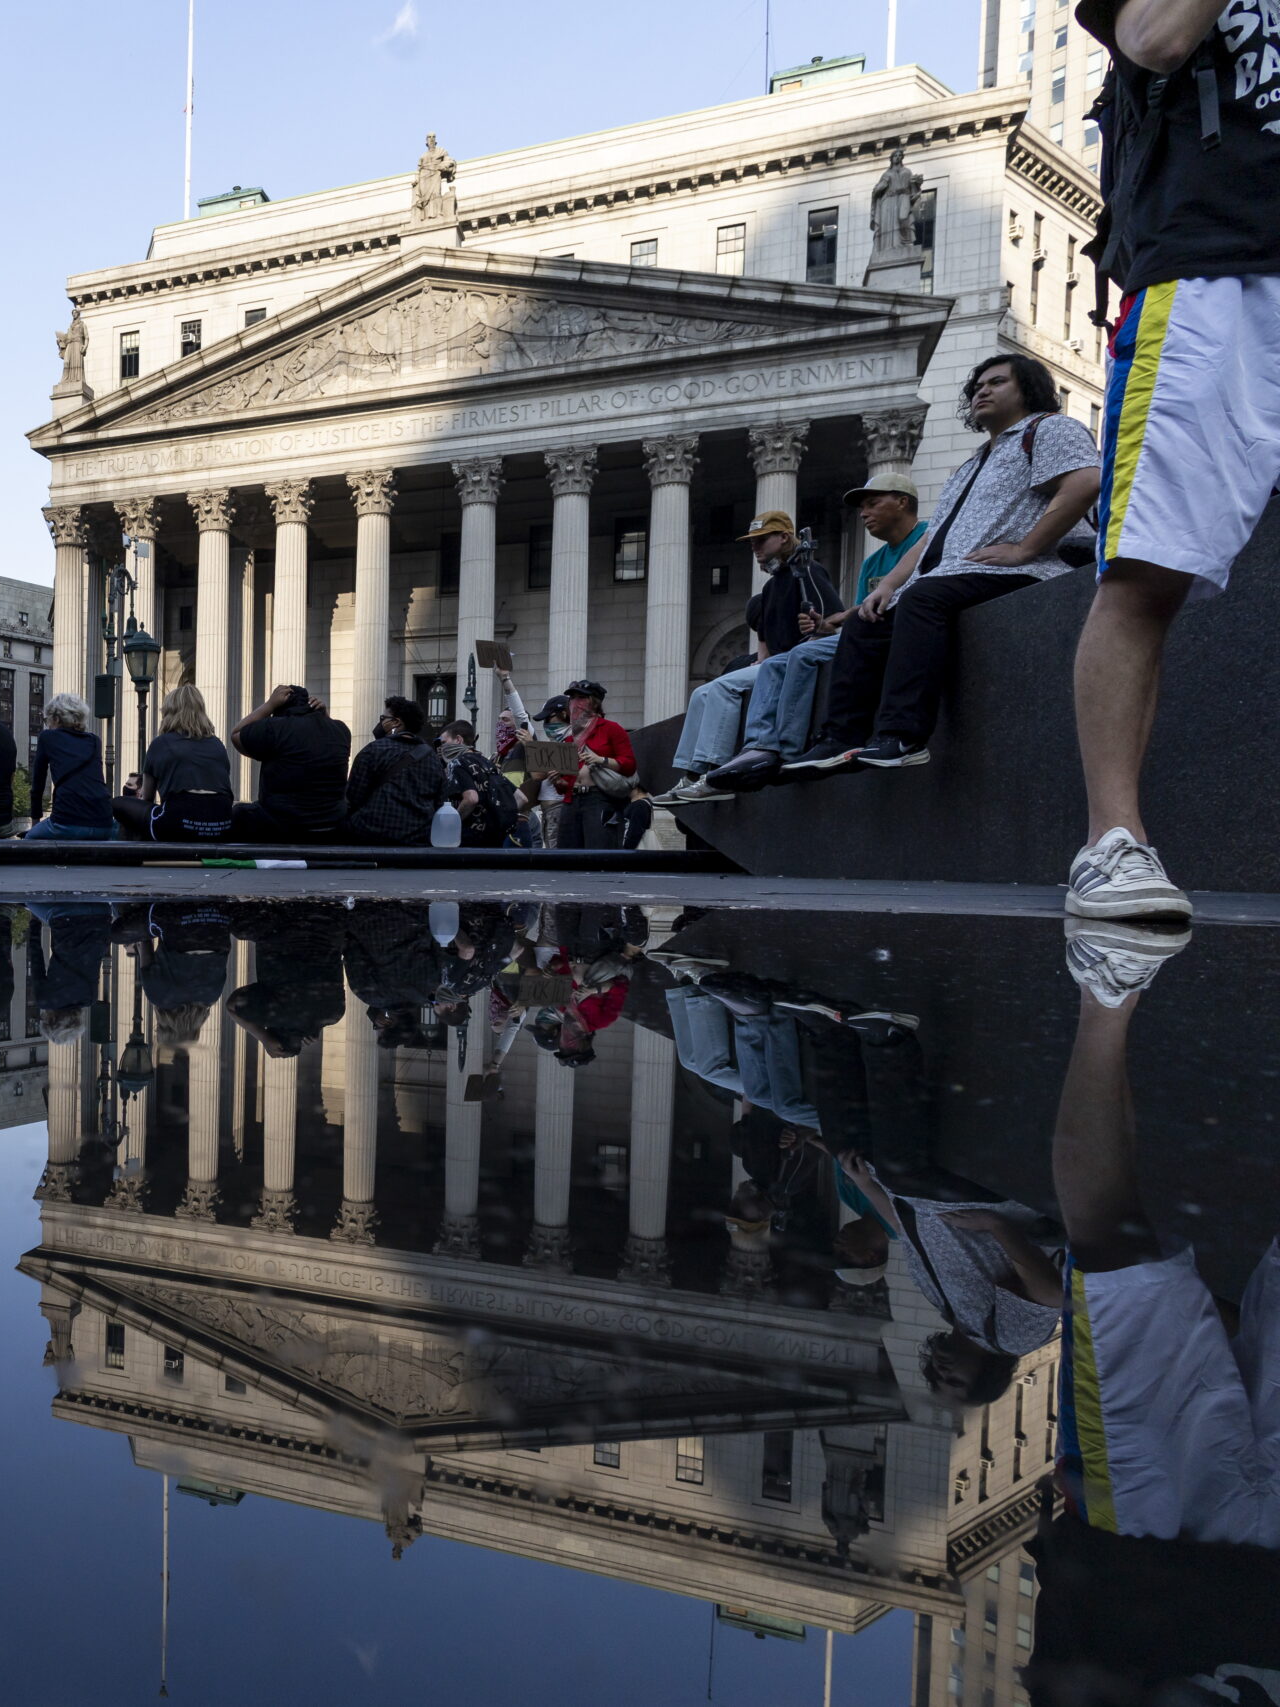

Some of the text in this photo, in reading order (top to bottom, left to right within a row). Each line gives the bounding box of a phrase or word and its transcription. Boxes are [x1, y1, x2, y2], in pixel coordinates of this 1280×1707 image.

[66, 356, 893, 478] THE TRUE ADMINISTRATION OF JUSTICE IS THE FIRMEST PILLAR OF GOOD GOVERNMENT
